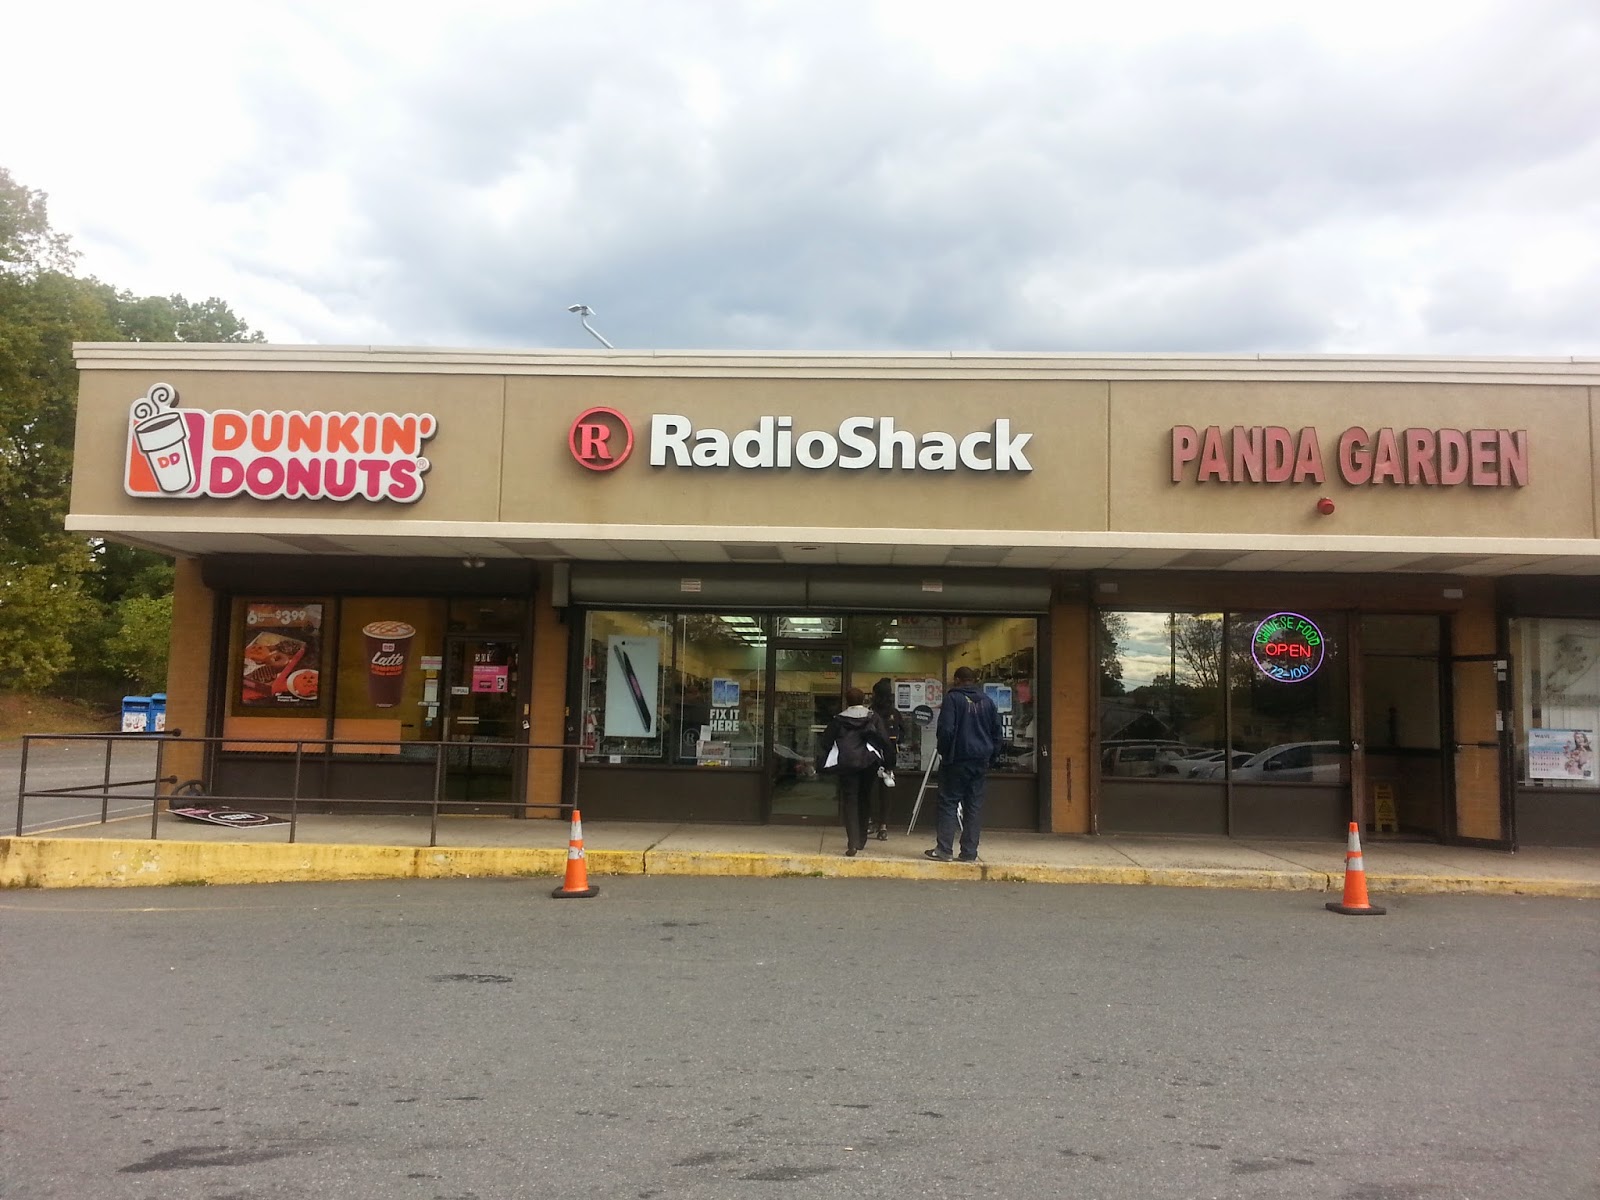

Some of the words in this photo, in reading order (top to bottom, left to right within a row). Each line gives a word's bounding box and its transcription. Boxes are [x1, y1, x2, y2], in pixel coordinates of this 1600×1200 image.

[212, 413, 431, 455] DUNKIN'
[650, 414, 1034, 472] RadioShack
[157, 452, 180, 469] DD
[1171, 425, 1326, 483] PANDA
[1338, 426, 1530, 487] GARDEN
[209, 457, 417, 499] DONUTS
[247, 610, 257, 624] 6
[1256, 616, 1295, 644] CHINESE
[1295, 620, 1321, 646] FOOD
[371, 651, 404, 666] Latte
[1265, 643, 1312, 657] OPEN
[709, 709, 727, 719] FIX
[730, 709, 740, 720] IT
[710, 720, 740, 731] HERE
